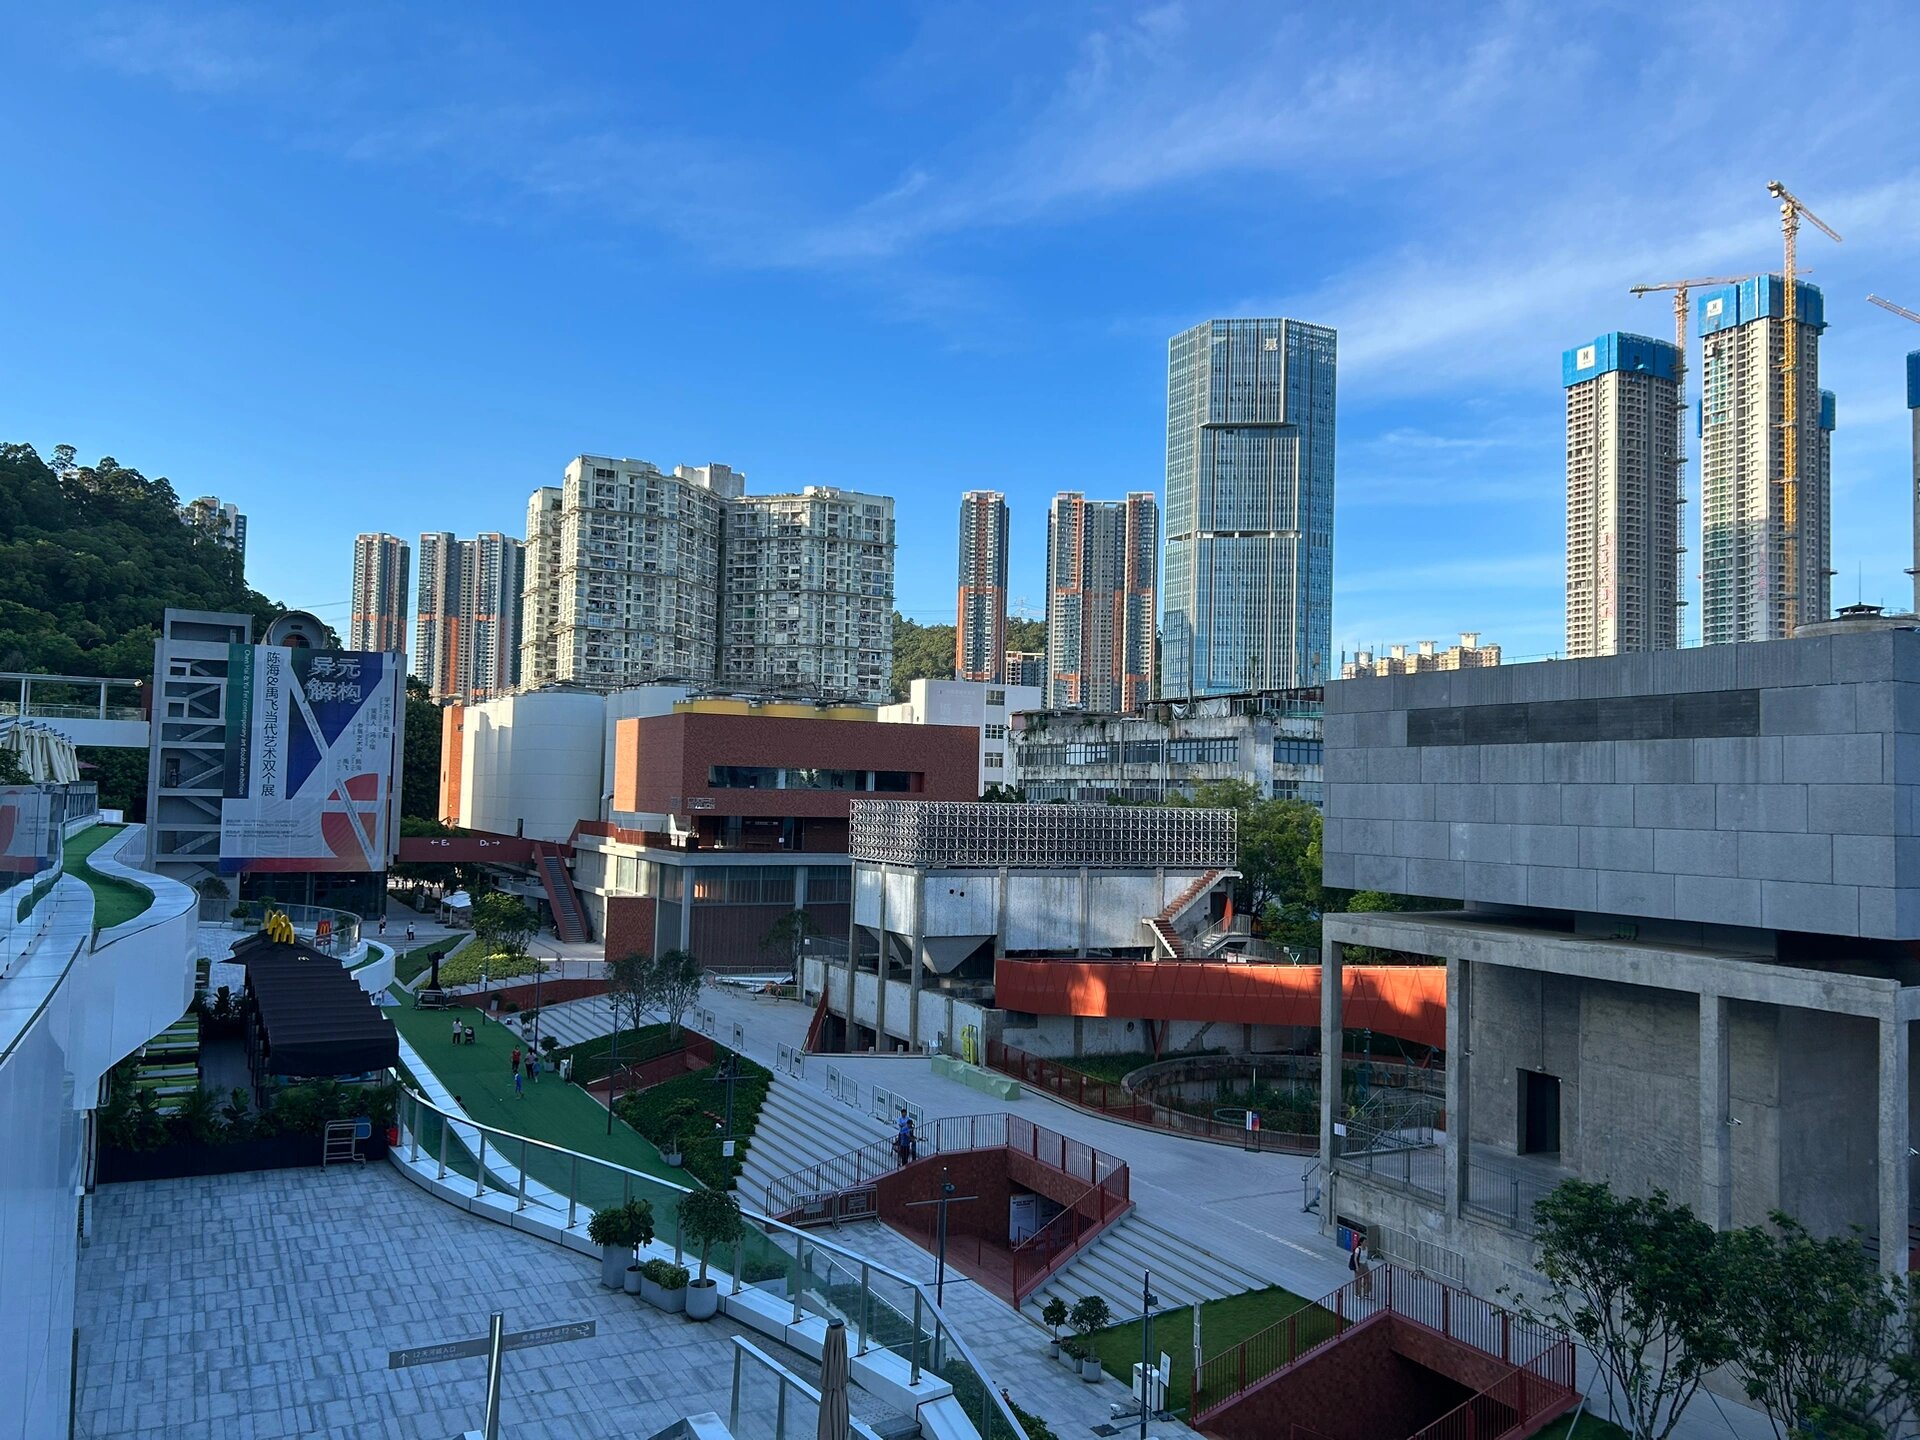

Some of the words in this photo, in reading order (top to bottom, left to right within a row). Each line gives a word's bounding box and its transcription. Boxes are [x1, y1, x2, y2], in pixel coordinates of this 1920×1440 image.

[261, 651, 281, 797] 陈海&禹飞当代艺术双个展
[304, 677, 362, 704] 解构
